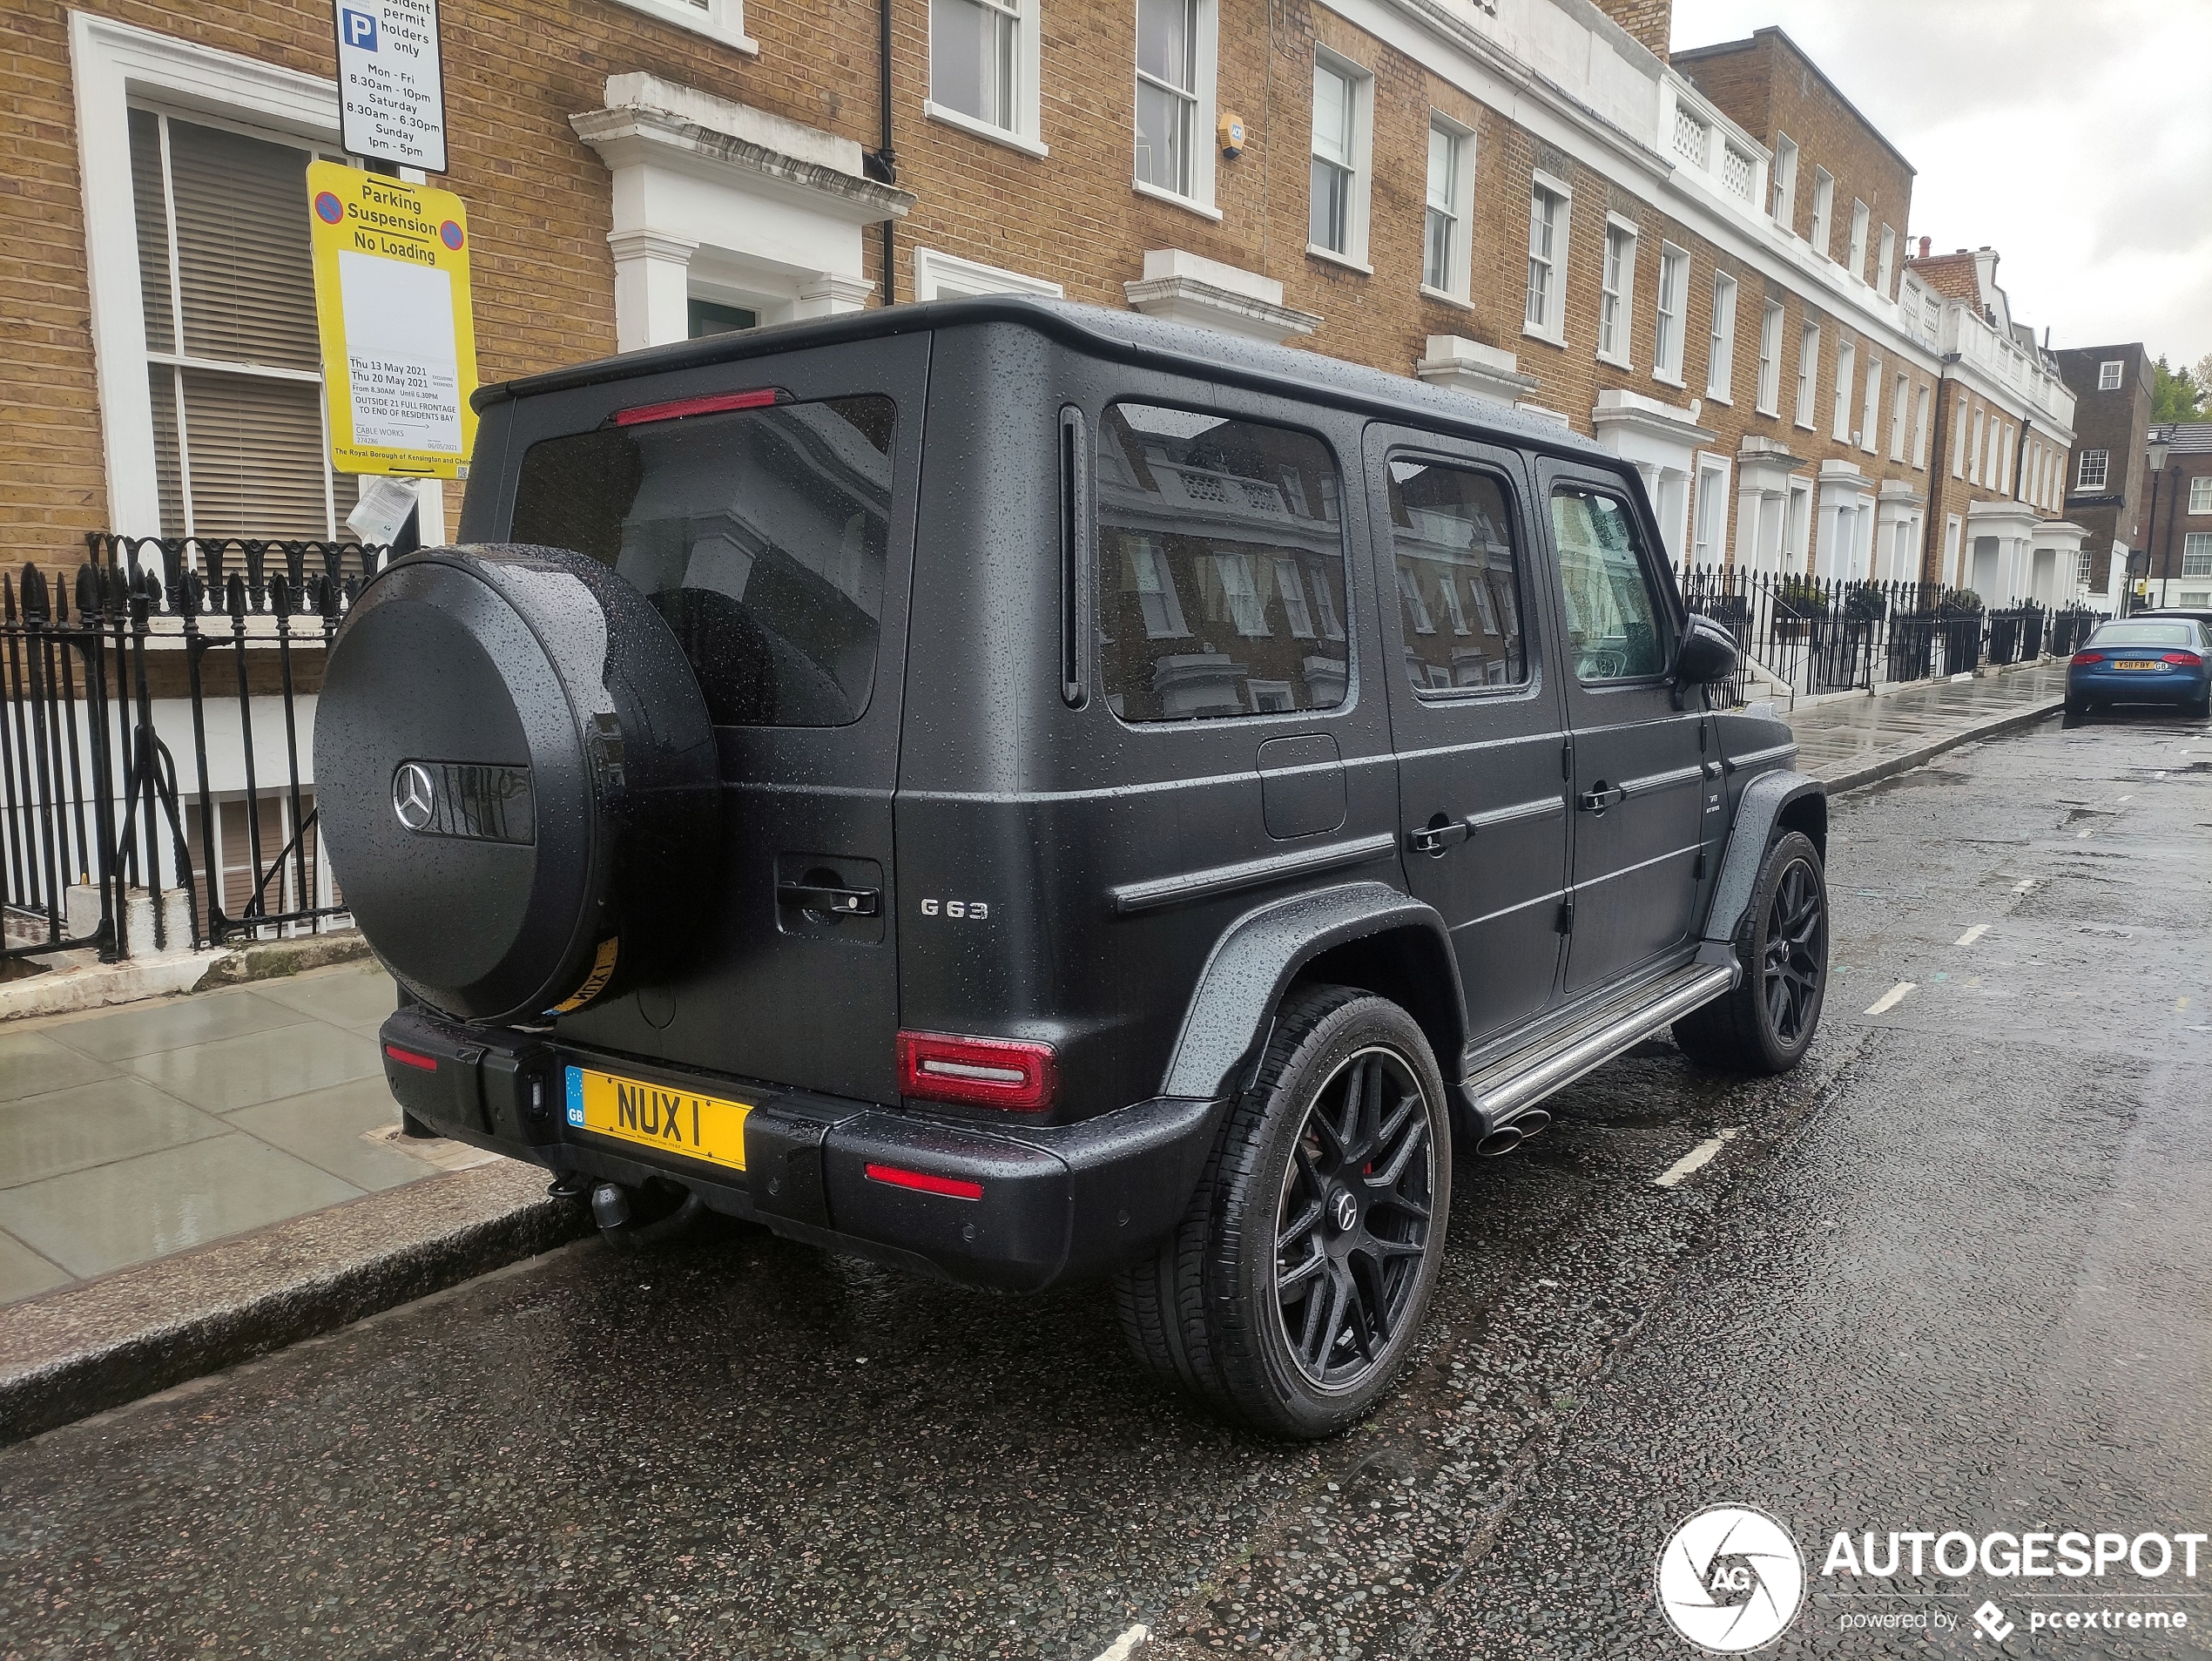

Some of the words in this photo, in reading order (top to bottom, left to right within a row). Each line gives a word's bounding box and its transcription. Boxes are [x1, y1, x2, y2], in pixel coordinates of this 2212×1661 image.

[384, 7, 426, 27] permit
[351, 13, 371, 44] P
[381, 21, 429, 44] holders
[394, 42, 419, 57] only
[368, 64, 390, 78] Mon
[401, 72, 415, 84] Fri
[350, 74, 392, 92] 8.30am
[402, 88, 431, 103] 10pm
[369, 93, 417, 115] Saturday
[347, 103, 388, 120] 8.30am
[400, 115, 440, 133] 6.30pm
[375, 124, 414, 142] Sunday
[368, 137, 389, 150] 1pm
[400, 144, 423, 157] 5pm
[362, 185, 421, 215] Parking
[347, 202, 437, 236] Suspension
[354, 232, 375, 251] No
[381, 237, 435, 266] Loading
[350, 358, 368, 369] Thu
[370, 361, 381, 370] 13
[384, 362, 404, 375] May
[407, 366, 427, 376] 2021
[351, 371, 369, 381] Thu
[372, 374, 383, 383] 20
[386, 375, 405, 388] May
[408, 378, 428, 388] 2021
[353, 384, 369, 393] From
[370, 387, 395, 395] 8.30AM
[400, 389, 415, 398] Until
[416, 392, 438, 401] 6.30PM
[355, 396, 388, 406] OUTSIDE
[401, 401, 418, 409] FULL
[419, 402, 456, 414] FRONTAGE
[401, 410, 439, 421] RESIDENTS
[441, 414, 454, 422] BAY
[379, 429, 404, 437] WORKS
[370, 451, 398, 460] Borough
[408, 455, 441, 463] Kensington
[569, 1108, 583, 1123] GB
[617, 1084, 682, 1142] NUX
